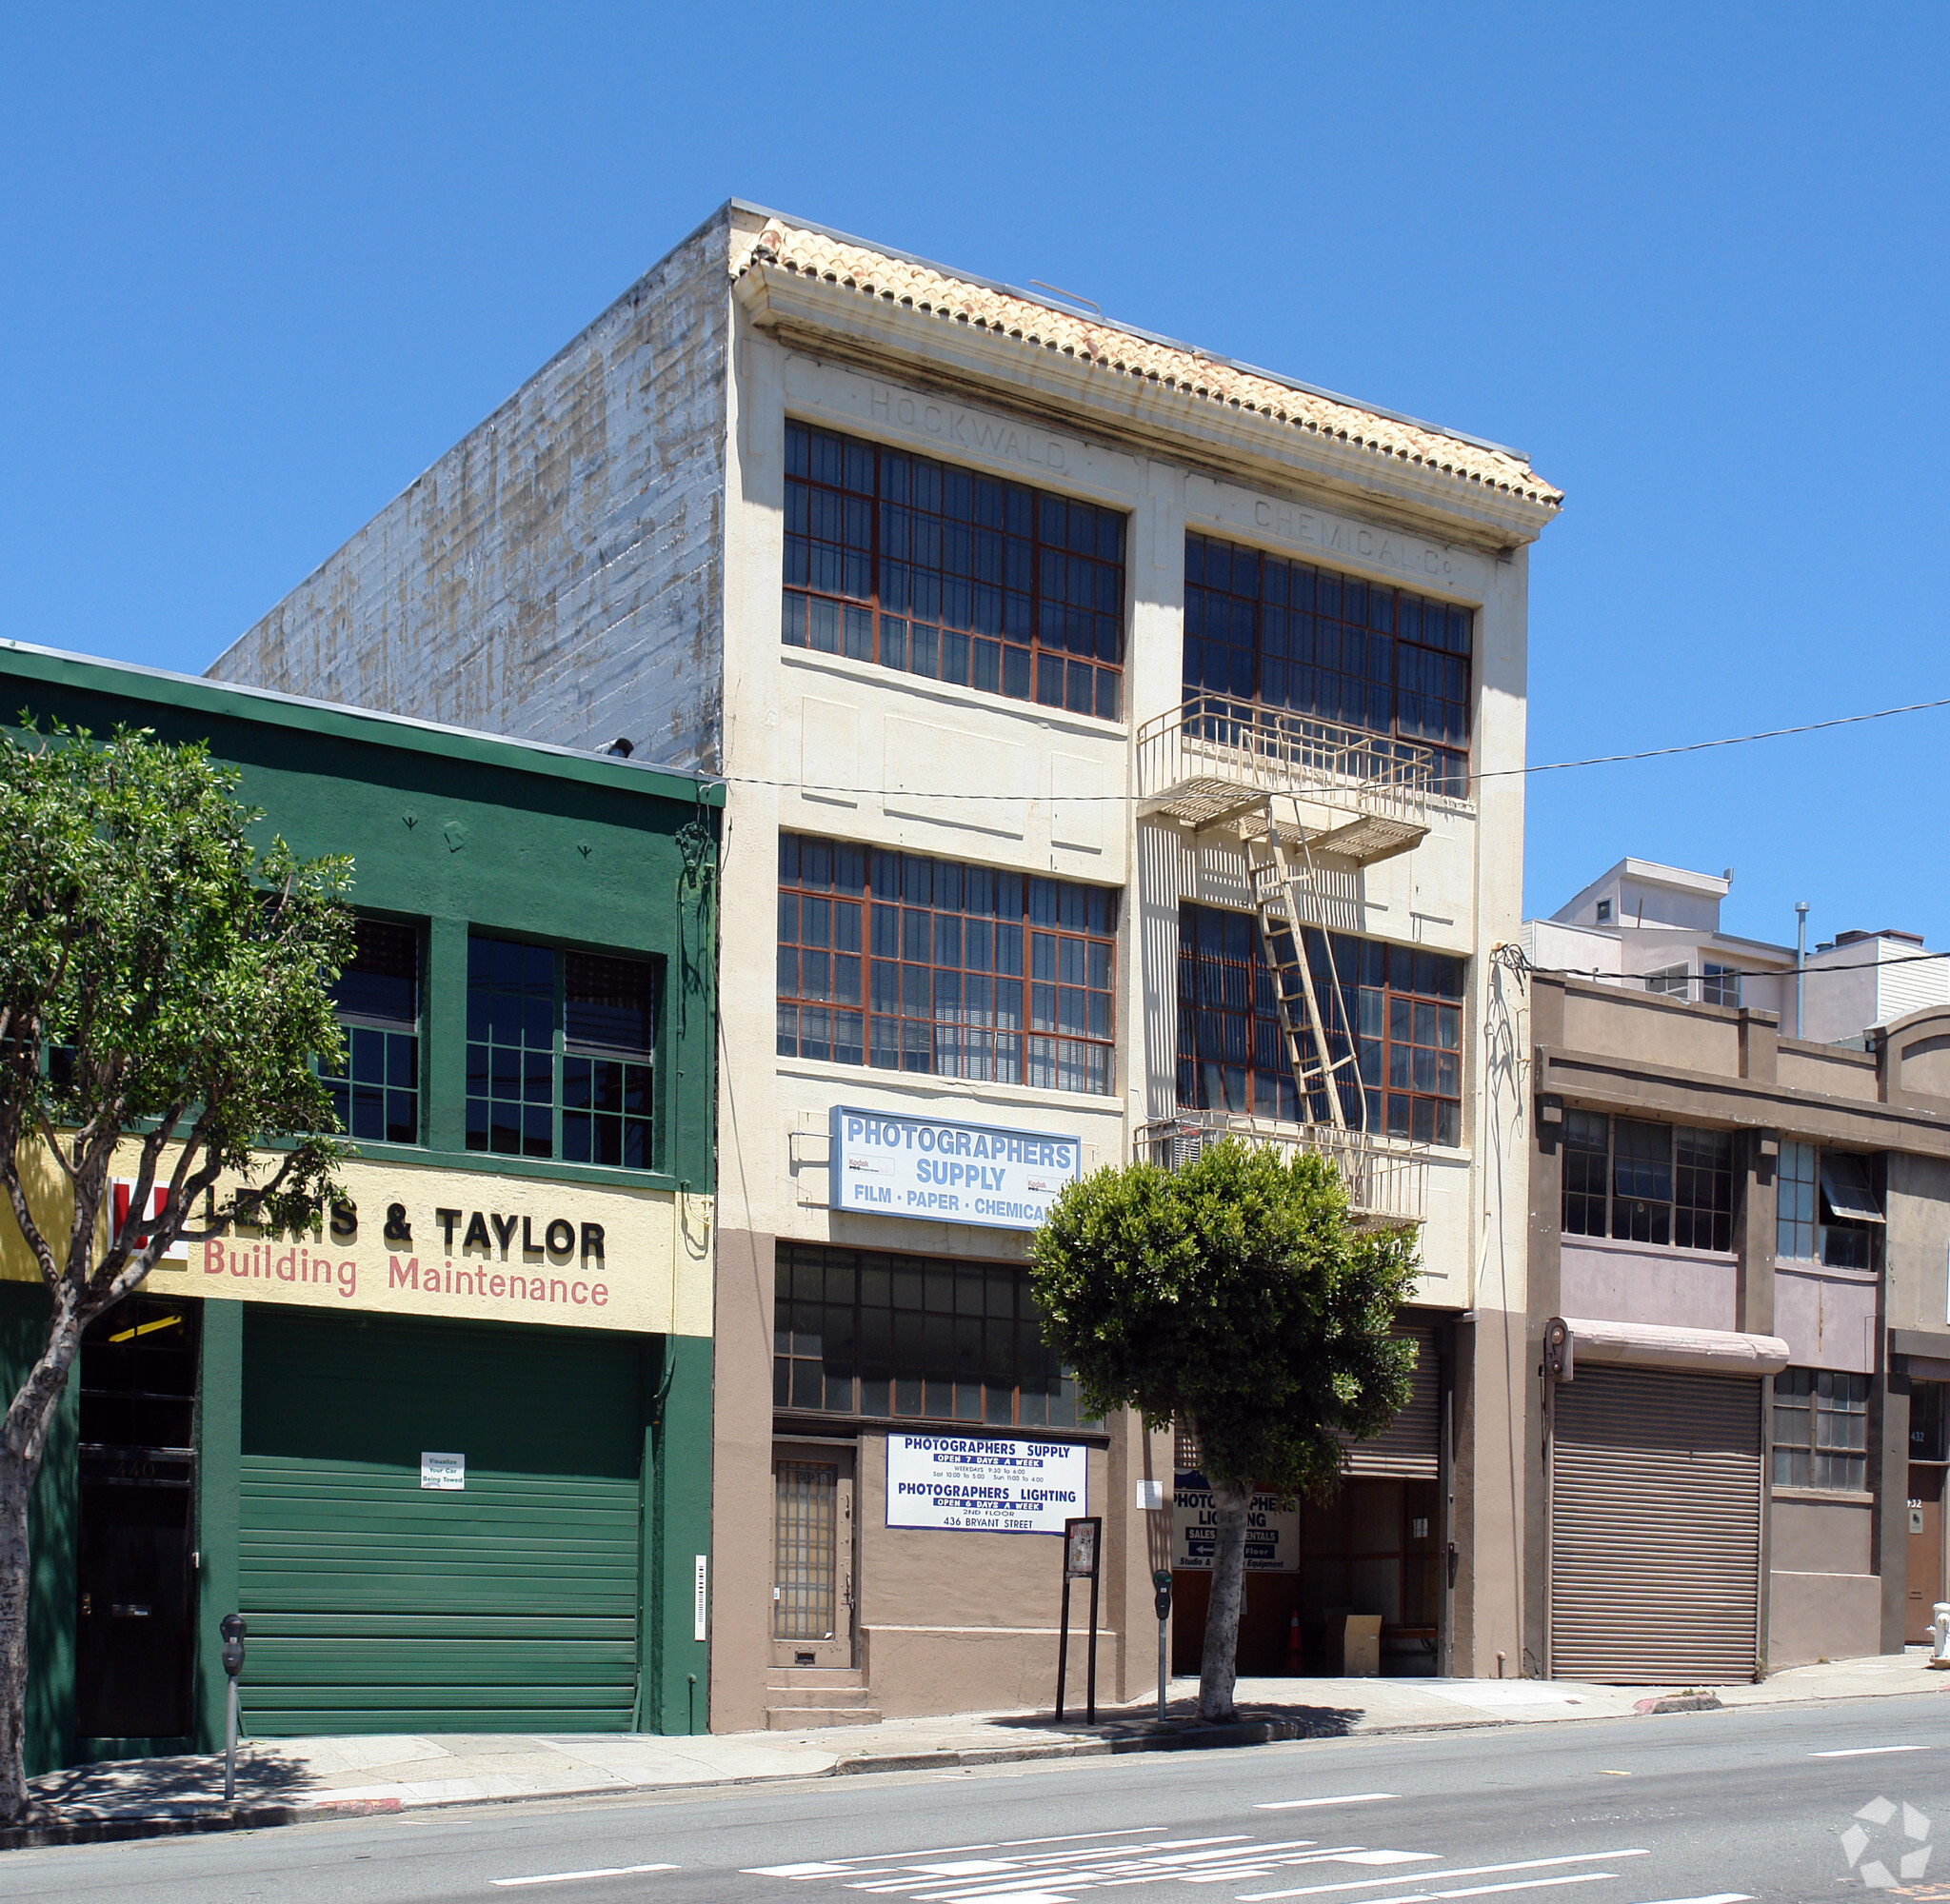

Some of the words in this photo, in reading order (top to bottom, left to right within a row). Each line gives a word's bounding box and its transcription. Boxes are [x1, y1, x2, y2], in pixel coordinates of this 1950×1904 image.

[870, 387, 1065, 468] HOCKWALD
[1254, 500, 1414, 569] CHEMICAL
[847, 1117, 1071, 1169] PHOTOGRAPHERS
[848, 1158, 869, 1167] Kodak
[916, 1158, 1006, 1192] SUPPLY
[854, 1183, 892, 1203] FILM
[906, 1189, 960, 1211] PAPER
[383, 1202, 413, 1241] &
[435, 1207, 607, 1259] TAYLOR
[204, 1239, 357, 1299] Building
[388, 1255, 609, 1307] Maintenance
[1910, 1431, 1925, 1442] 432
[905, 1437, 1016, 1456] PHOTOGRAPHERS
[1026, 1444, 1071, 1458] SUPPLY
[937, 1455, 961, 1463] OPEN
[114, 1460, 156, 1478] 440
[898, 1481, 1010, 1500] PHOTOGRAPHERS
[1020, 1488, 1077, 1503] LIGHTING
[937, 1498, 961, 1507] OPEN
[943, 1517, 962, 1526] 436
[965, 1517, 1000, 1528] BRYANT
[1004, 1518, 1034, 1529] STREET
[1188, 1528, 1216, 1539] SALES
[1245, 1531, 1276, 1541] ENTALS
[1245, 1547, 1269, 1556] Floor
[1180, 1557, 1204, 1566] Studio
[1246, 1559, 1284, 1569] Equipment
